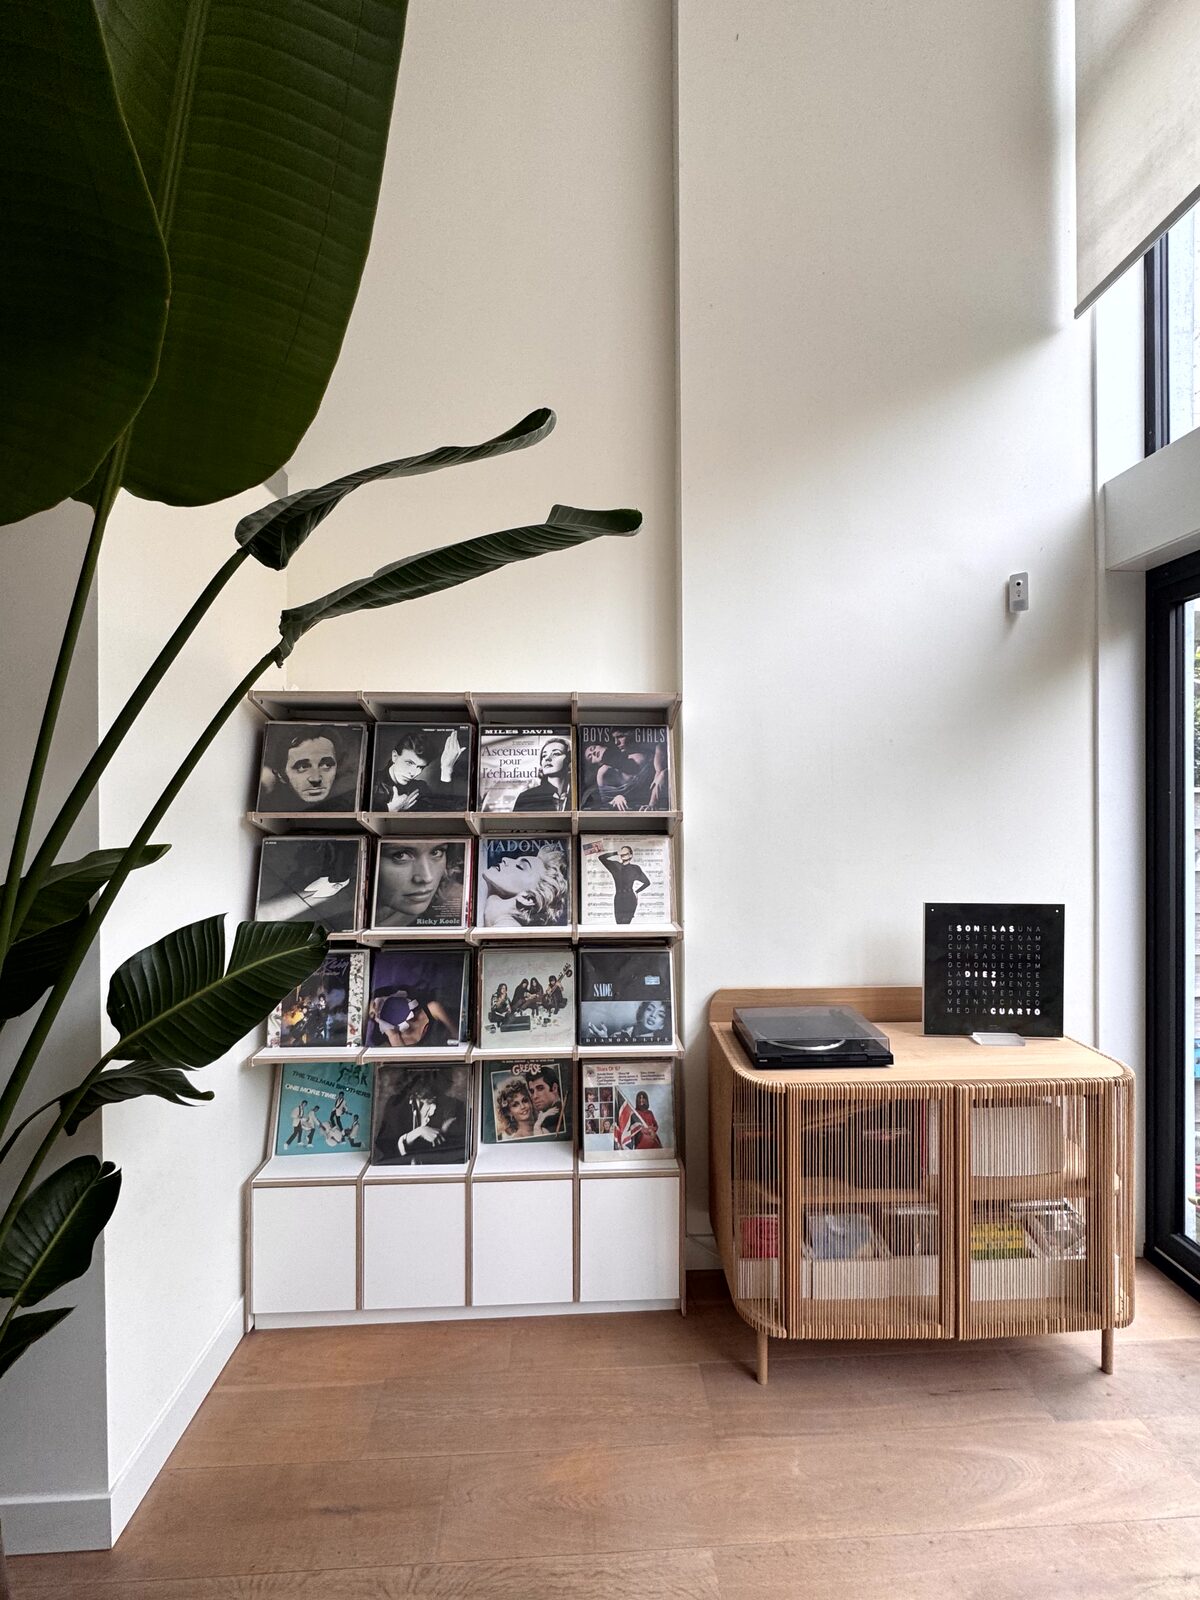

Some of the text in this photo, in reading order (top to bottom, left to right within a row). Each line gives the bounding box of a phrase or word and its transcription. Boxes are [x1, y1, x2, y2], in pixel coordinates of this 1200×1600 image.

[583, 727, 610, 743] BOYS
[635, 728, 665, 743] GIRLS
[482, 746, 540, 757] Ascenseur
[499, 759, 522, 767] pour
[484, 839, 565, 852] MADONNA
[593, 983, 613, 997] SADE
[512, 1063, 541, 1076] GREASE
[292, 1070, 306, 1079] THE
[335, 1082, 371, 1099] BROTHERS
[284, 1084, 337, 1100] ONE MORE TIME
